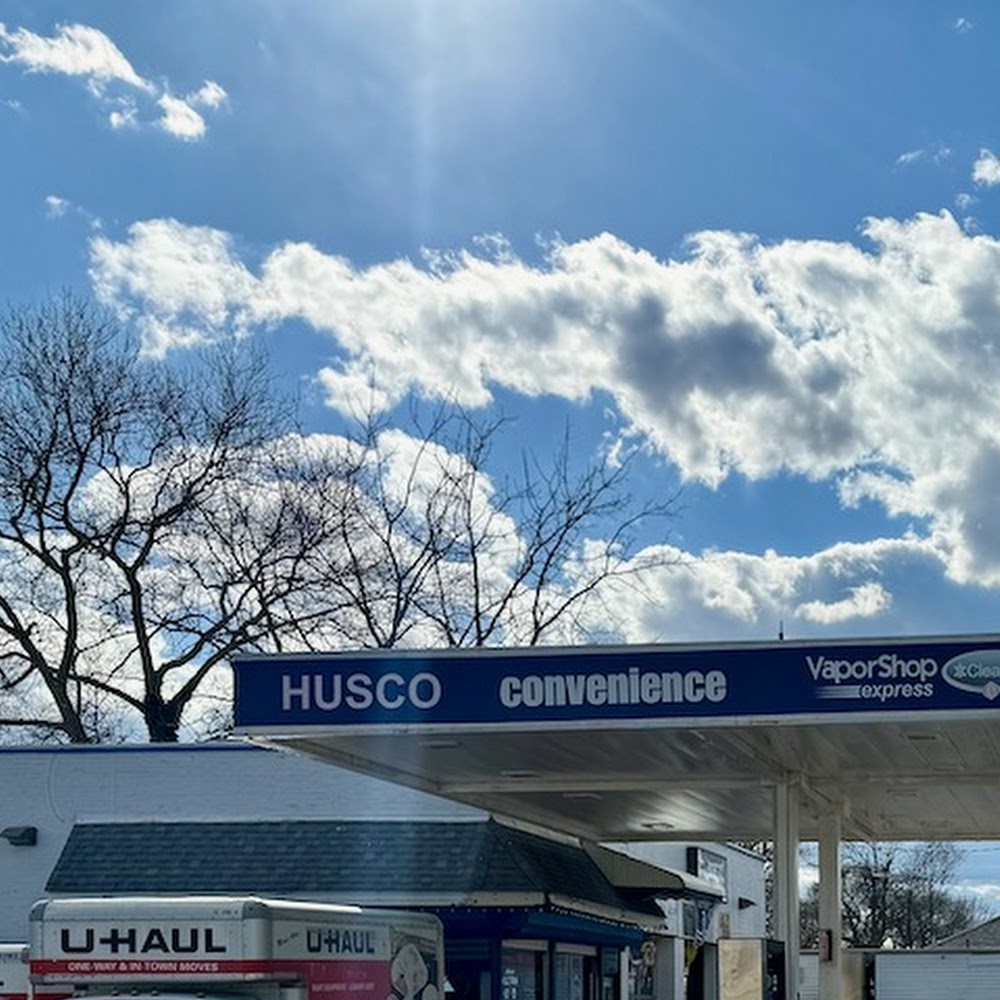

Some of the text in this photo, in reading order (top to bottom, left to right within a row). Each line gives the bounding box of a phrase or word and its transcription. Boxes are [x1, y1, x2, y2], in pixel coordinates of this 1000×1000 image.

[806, 654, 937, 684] VaporShop
[281, 672, 442, 711] HUSCO
[500, 667, 727, 709] convenience
[860, 681, 934, 702] express
[61, 928, 227, 953] U-HAUL
[307, 928, 376, 954] U-HAUL
[68, 961, 118, 972] ONE-WAY
[179, 961, 219, 972] MOVES
